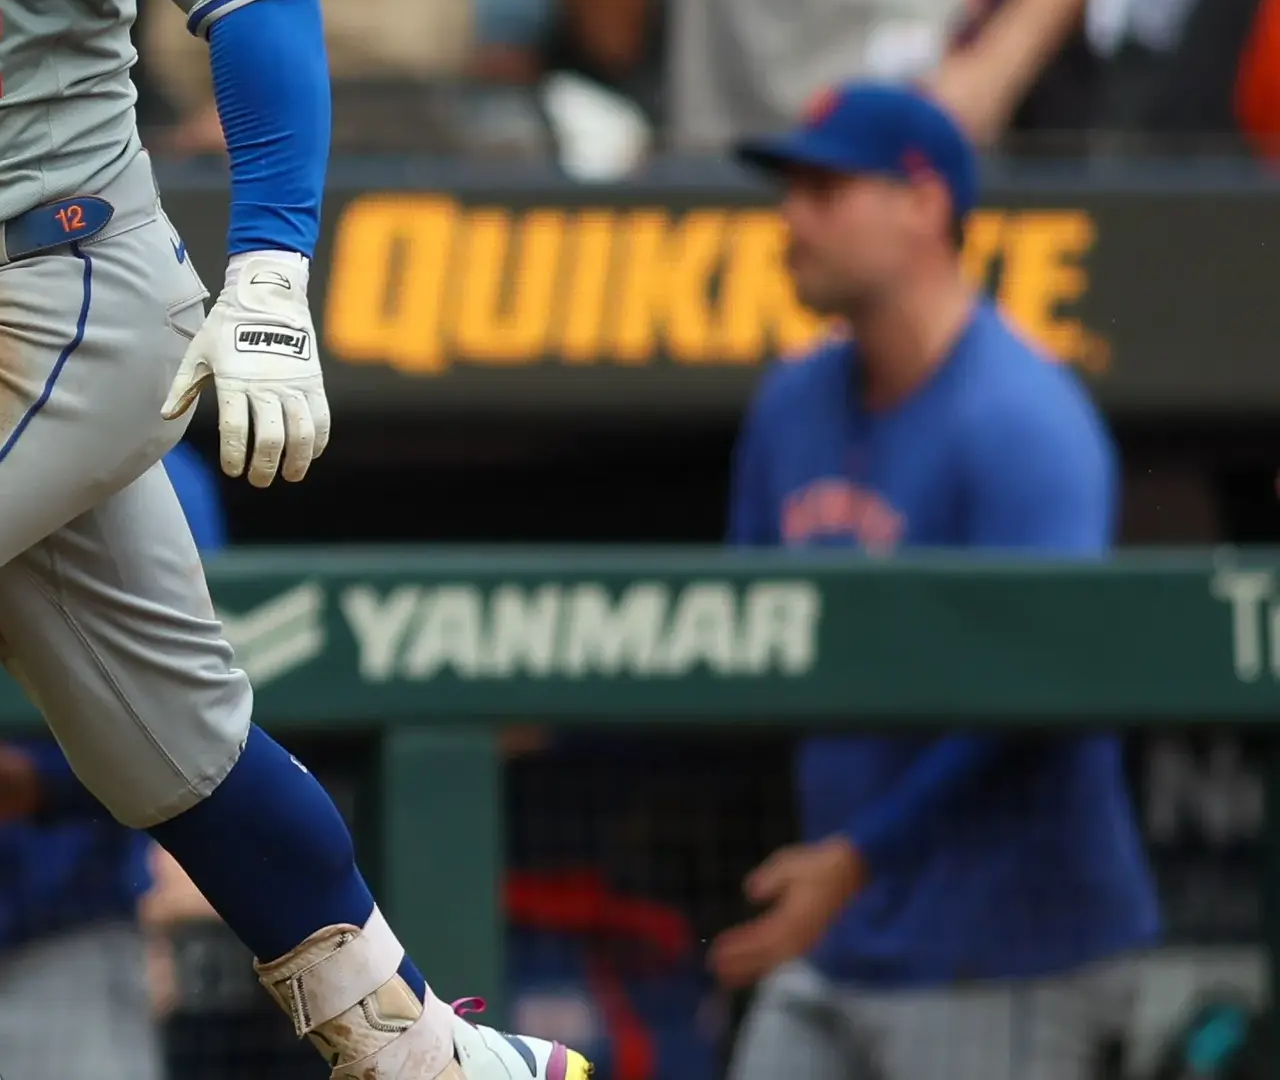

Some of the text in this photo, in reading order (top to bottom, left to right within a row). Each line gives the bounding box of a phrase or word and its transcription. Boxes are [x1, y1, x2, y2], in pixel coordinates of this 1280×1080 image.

[54, 205, 87, 232] 12
[239, 331, 307, 355] Franklin
[342, 580, 822, 682] YANMAR
